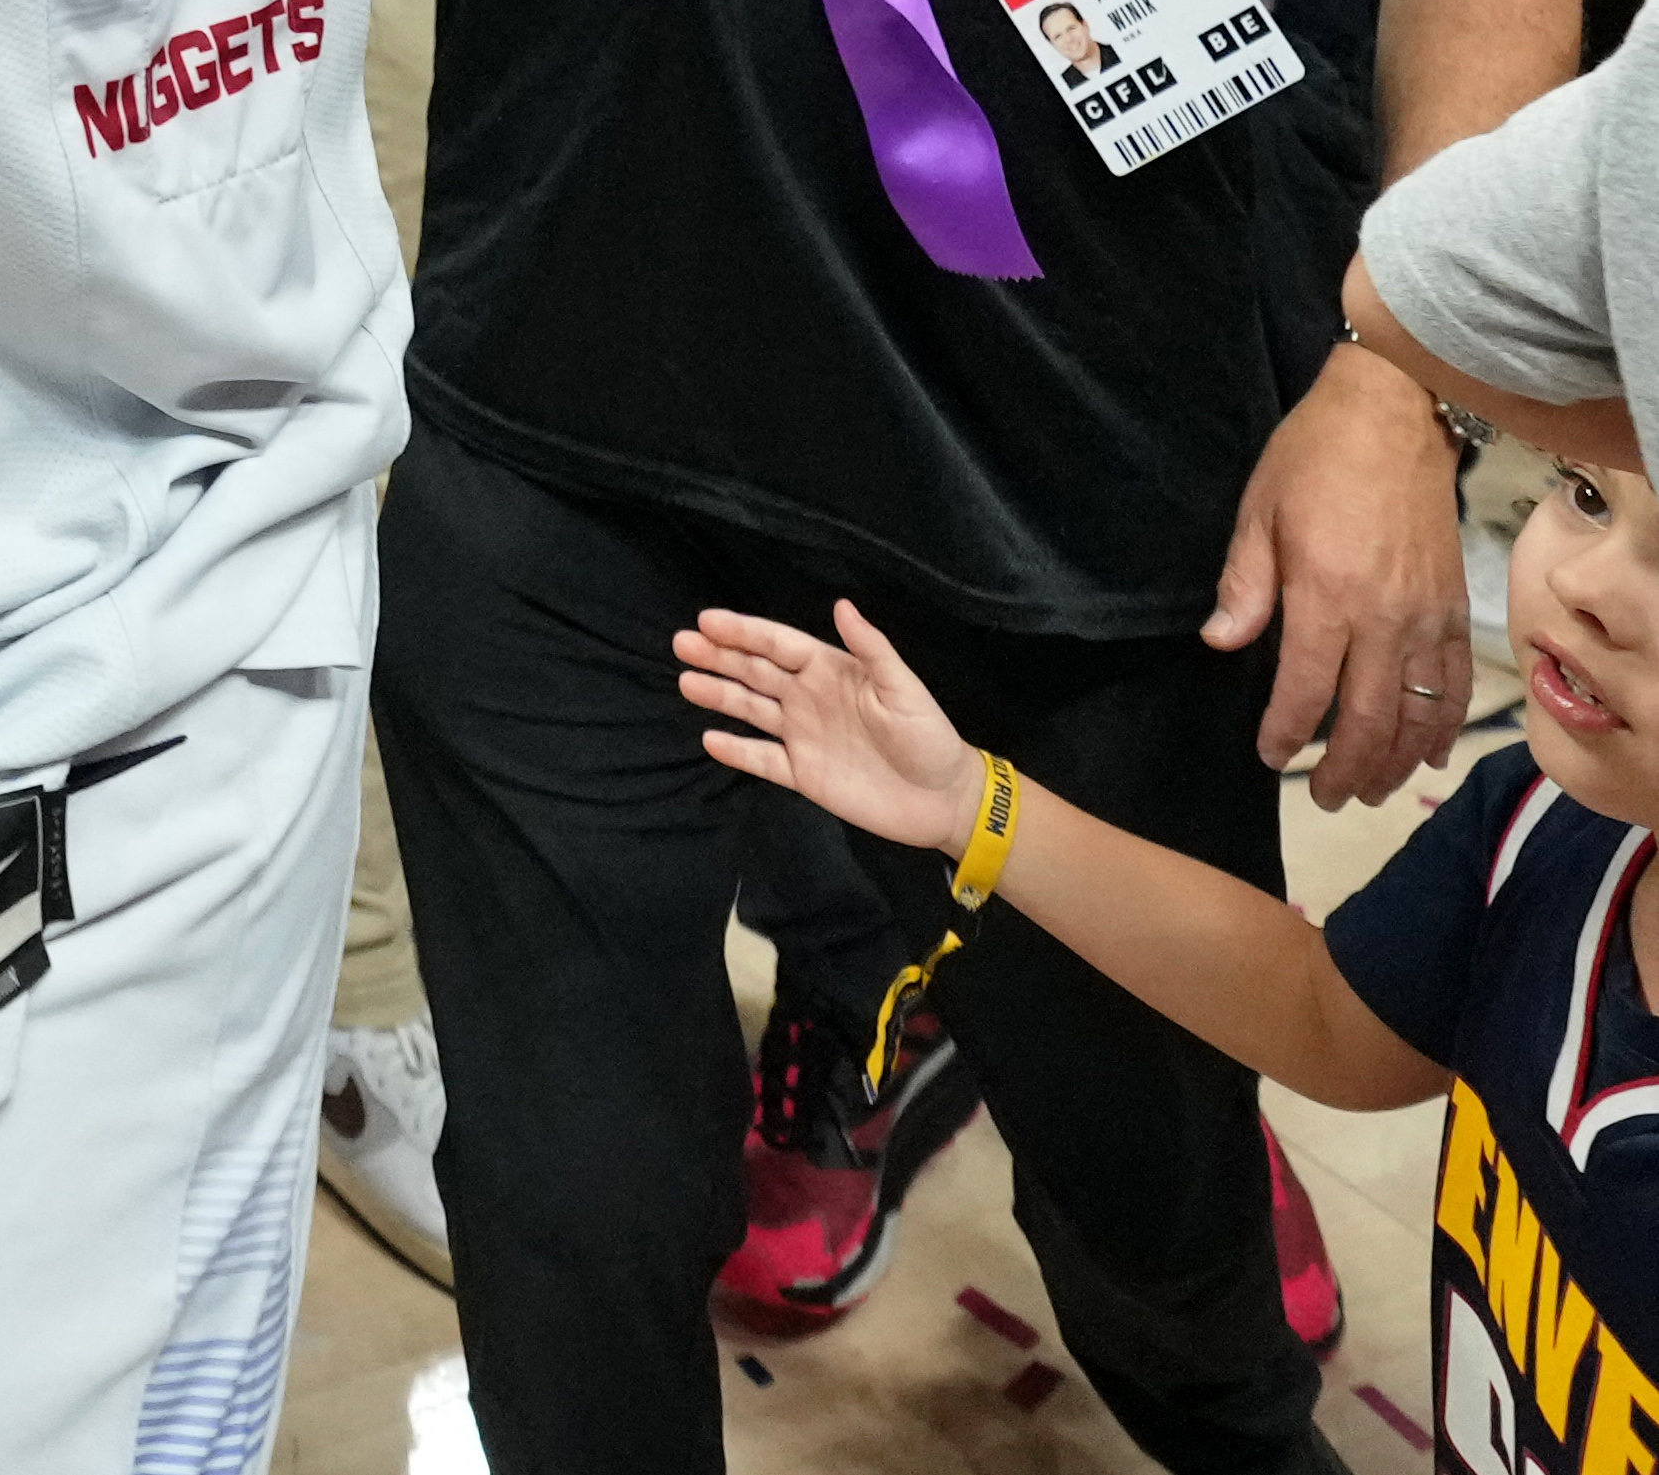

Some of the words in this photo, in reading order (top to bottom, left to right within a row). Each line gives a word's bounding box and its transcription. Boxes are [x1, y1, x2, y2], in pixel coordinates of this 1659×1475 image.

[1206, 32, 1228, 53] B
[1239, 13, 1261, 35] E
[1085, 104, 1104, 122] C
[1116, 82, 1132, 104] F
[985, 780, 1013, 838] ROOM
